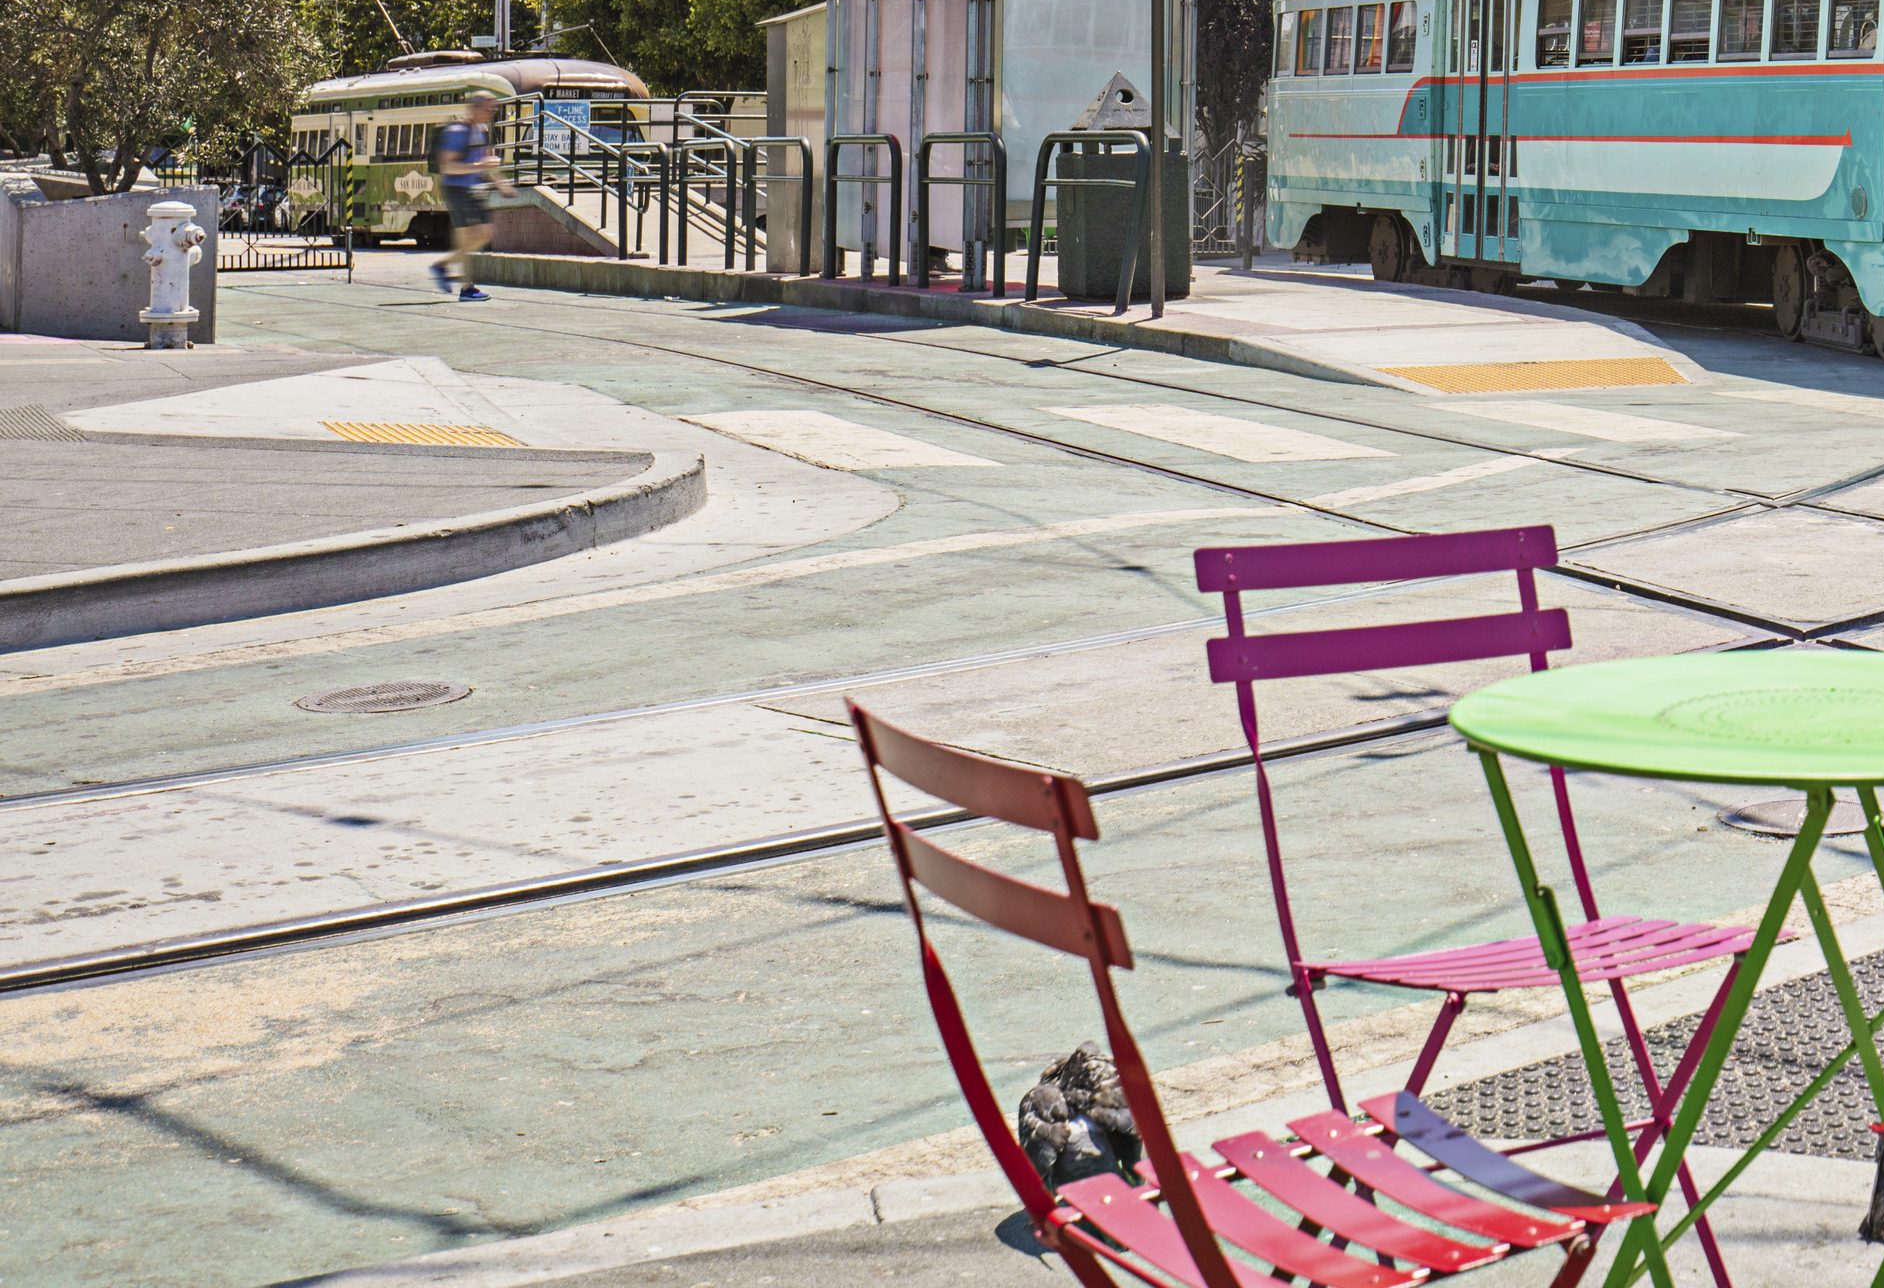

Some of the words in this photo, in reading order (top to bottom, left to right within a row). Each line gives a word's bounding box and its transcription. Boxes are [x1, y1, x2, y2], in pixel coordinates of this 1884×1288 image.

[557, 105, 584, 115] F-LINE
[561, 134, 580, 142] BAK
[543, 143, 560, 151] ROM
